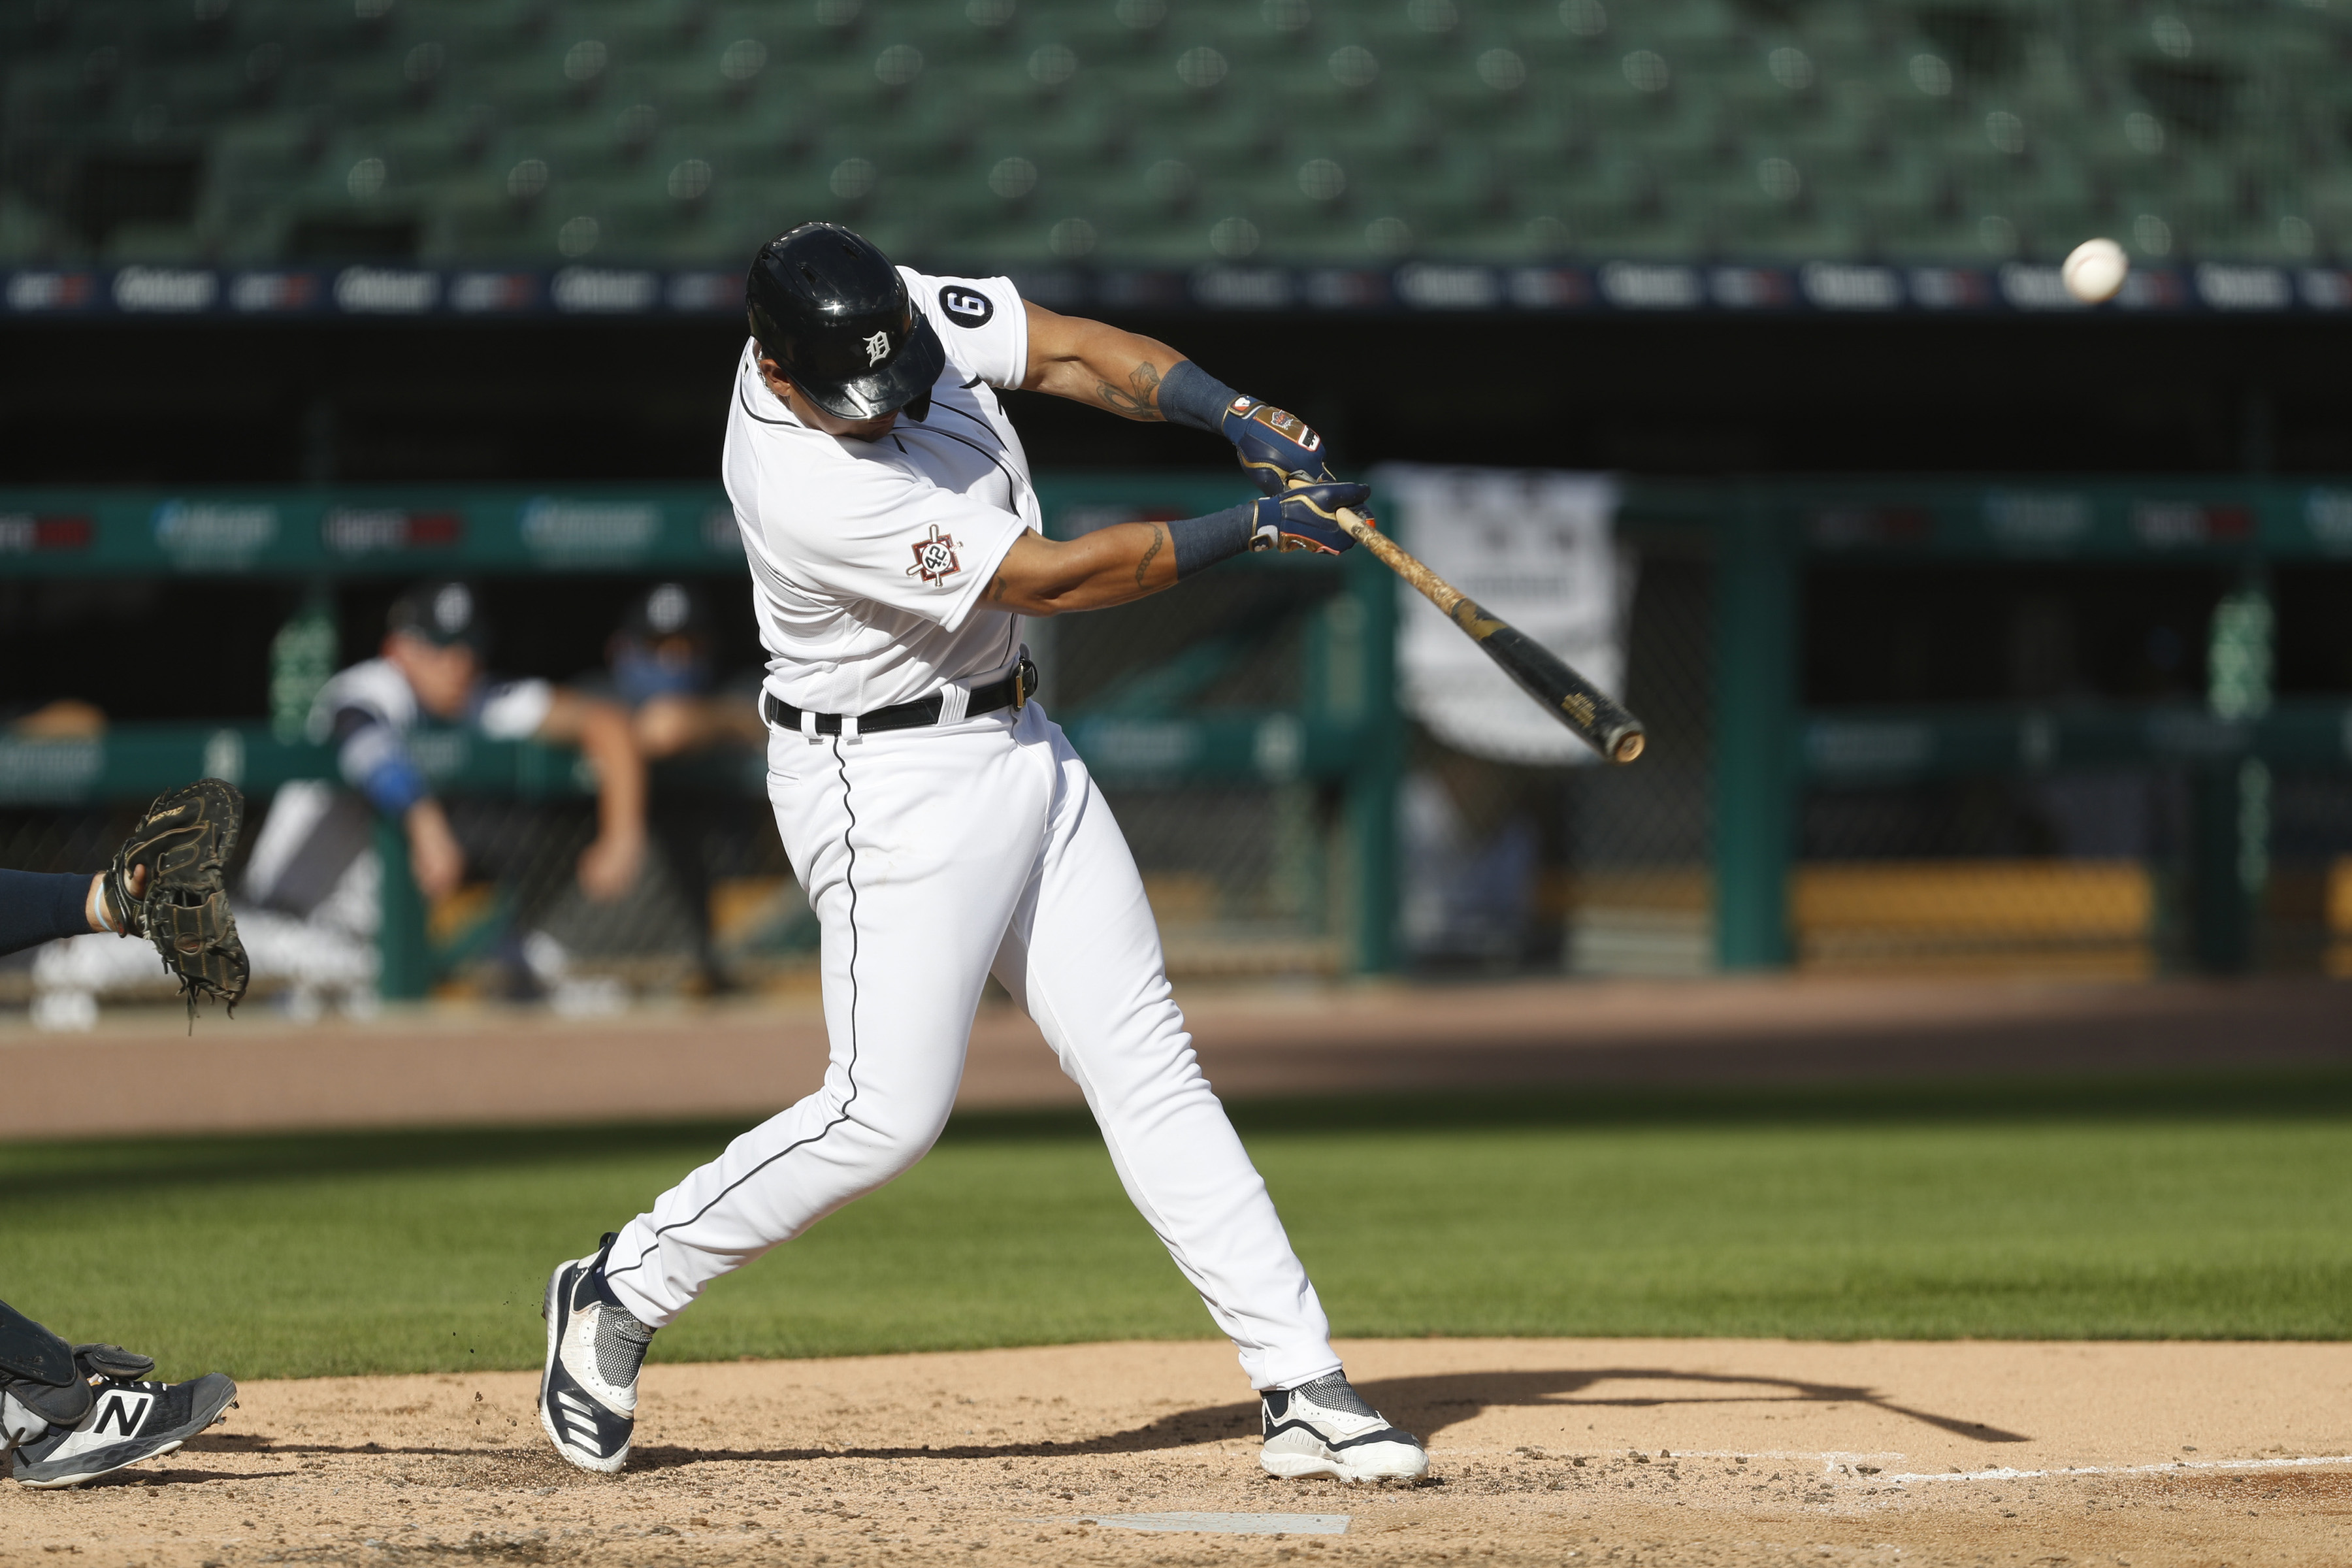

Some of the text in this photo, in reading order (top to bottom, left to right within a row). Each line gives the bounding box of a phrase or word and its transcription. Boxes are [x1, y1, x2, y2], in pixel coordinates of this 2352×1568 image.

[947, 292, 985, 316] 6
[862, 331, 890, 367] D
[924, 545, 947, 570] 42
[94, 1396, 149, 1437] N
